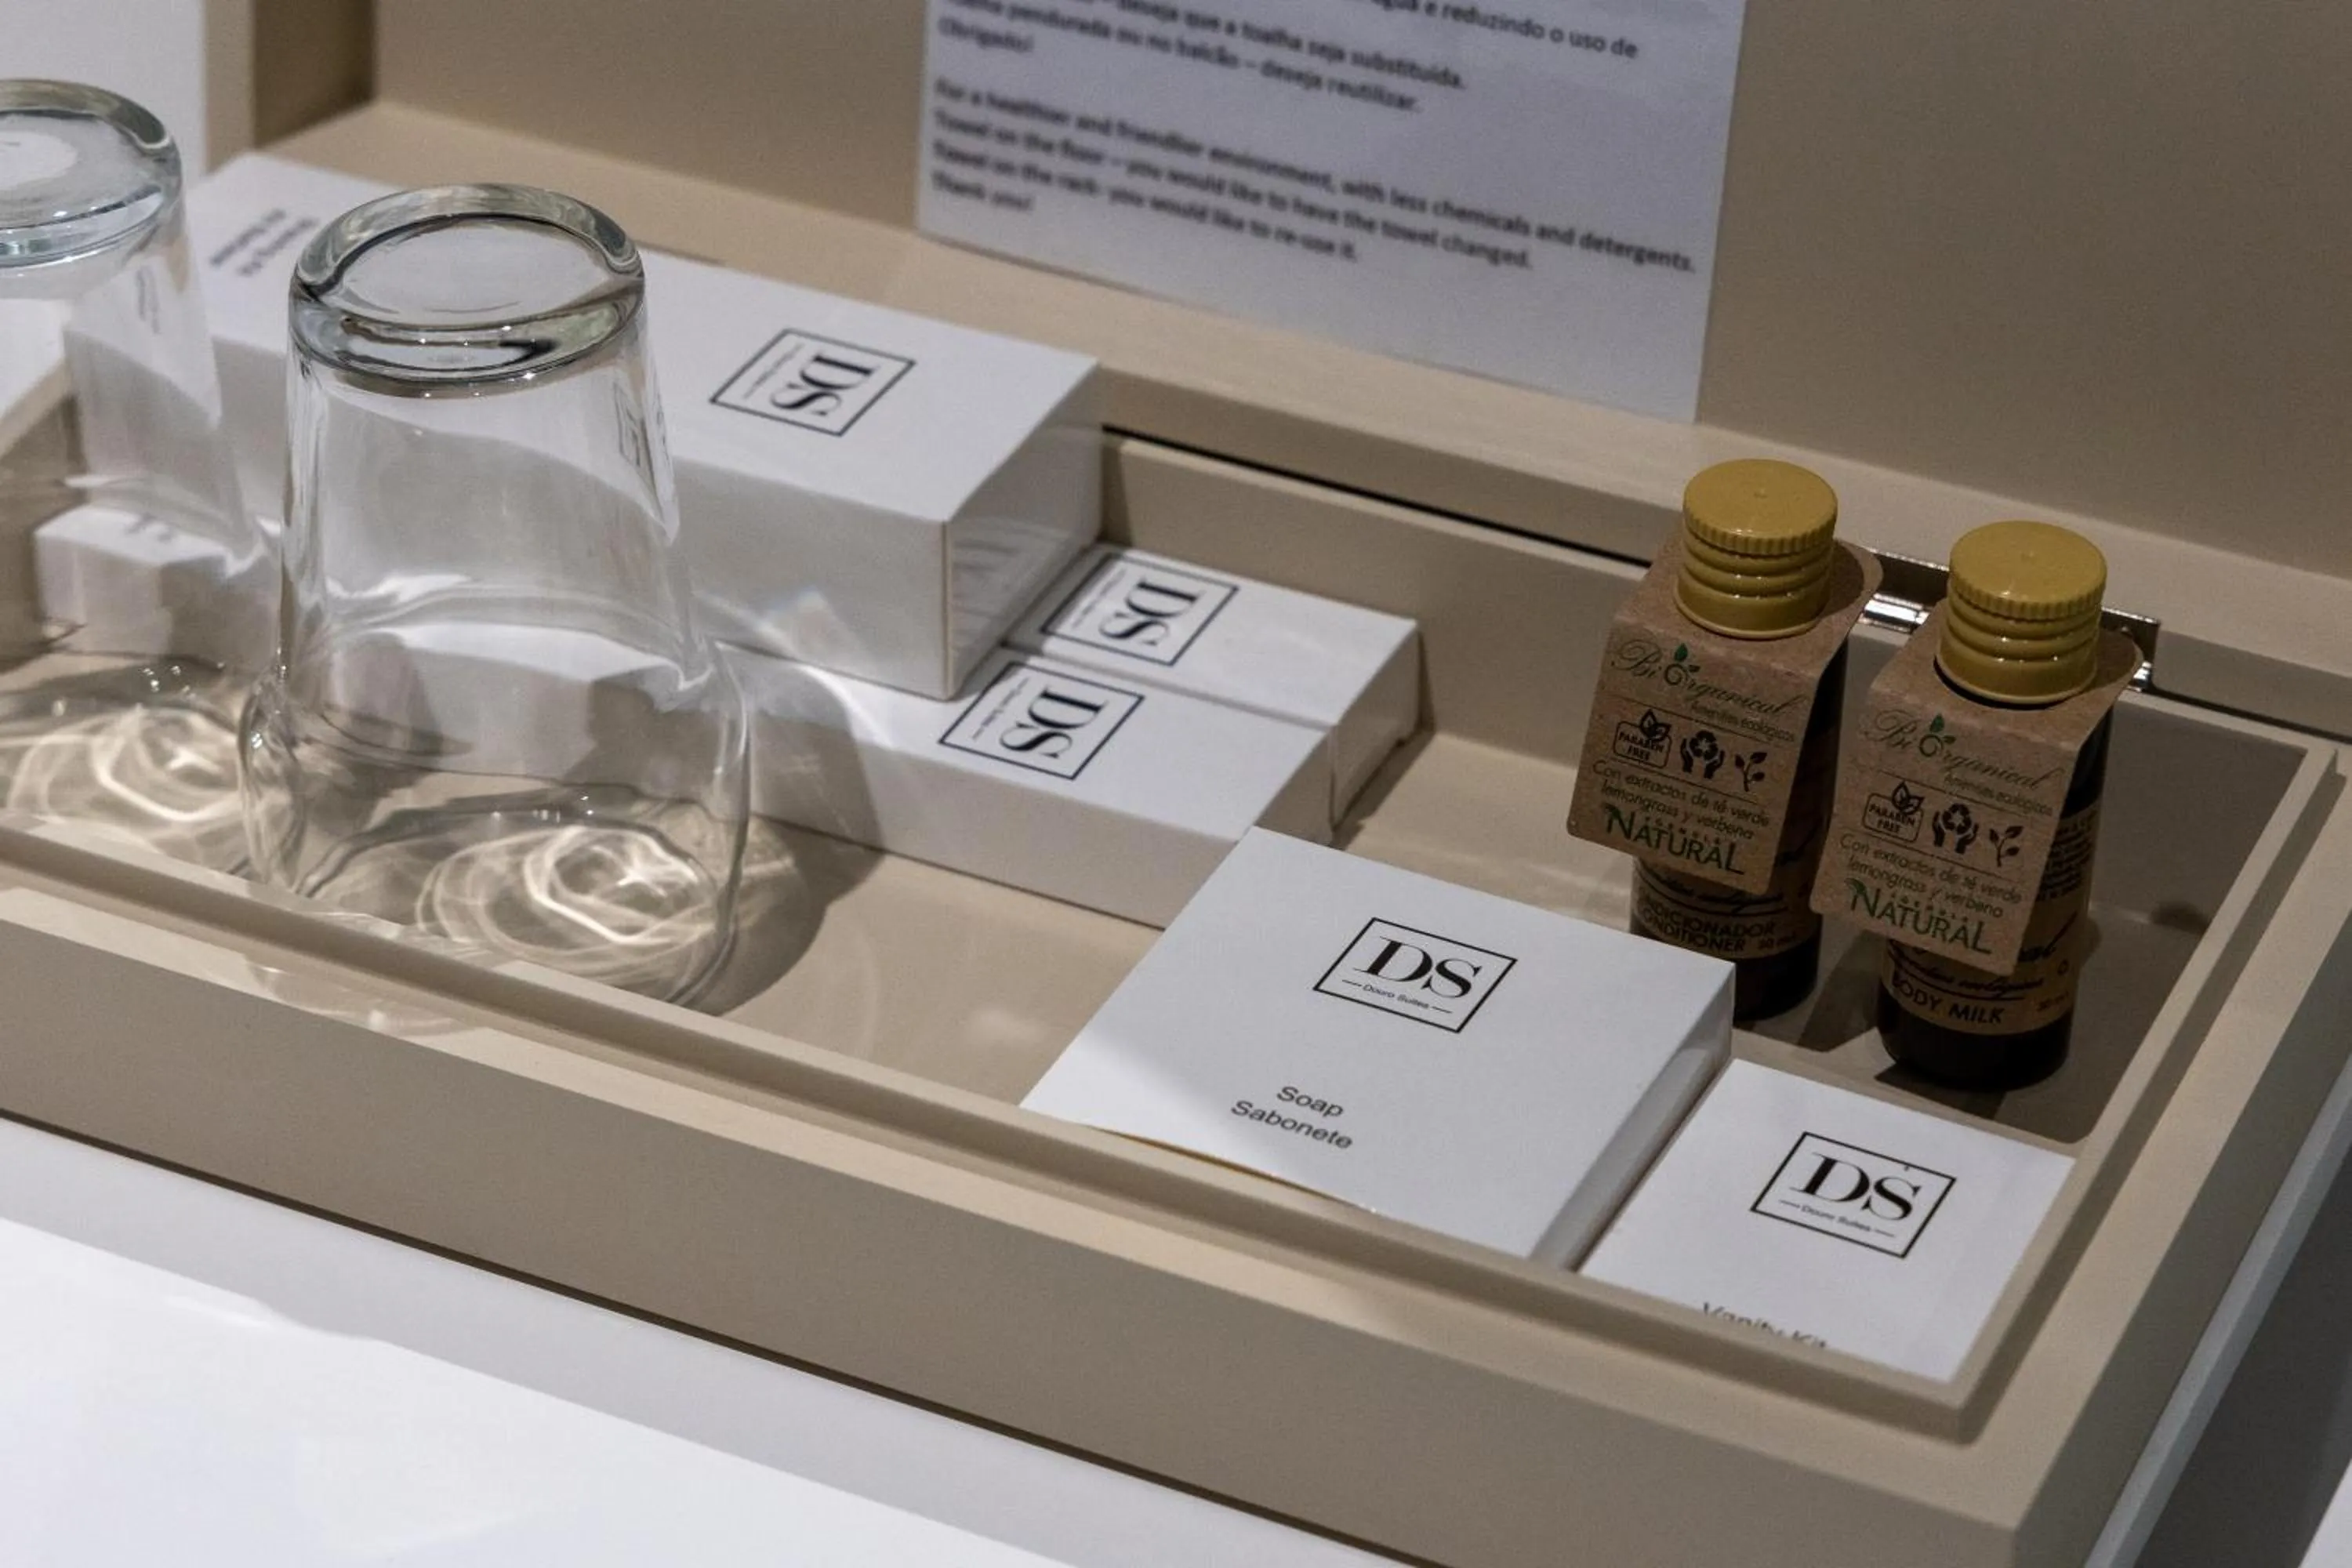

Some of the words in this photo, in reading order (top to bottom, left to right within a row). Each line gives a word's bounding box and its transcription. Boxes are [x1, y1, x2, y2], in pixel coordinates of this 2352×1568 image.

[1440, 3, 1546, 40] reduzindo
[1548, 27, 1566, 44] o
[1568, 31, 1606, 53] uso
[1610, 37, 1639, 60] de
[1388, 187, 1428, 214] less
[1430, 198, 1533, 238] chemicals
[1577, 230, 1695, 273] detergents.
[769, 350, 879, 416] DS
[1098, 579, 1206, 647] DS
[999, 687, 1108, 759] DS
[1592, 758, 1621, 780] Con
[1624, 773, 1686, 800] extractos
[1692, 792, 1709, 808] de
[1602, 804, 1744, 876] NATURAL
[1840, 832, 1870, 856] Con
[1872, 849, 1936, 877] extractos
[1939, 866, 1960, 884] de
[1844, 877, 1992, 954] NATURAL
[1353, 935, 1483, 999] DS
[1949, 1003, 2005, 1024] MILK
[1230, 1099, 1353, 1149] Sabonete
[1276, 1085, 1344, 1118] Soap
[1789, 1151, 1922, 1221] DS
